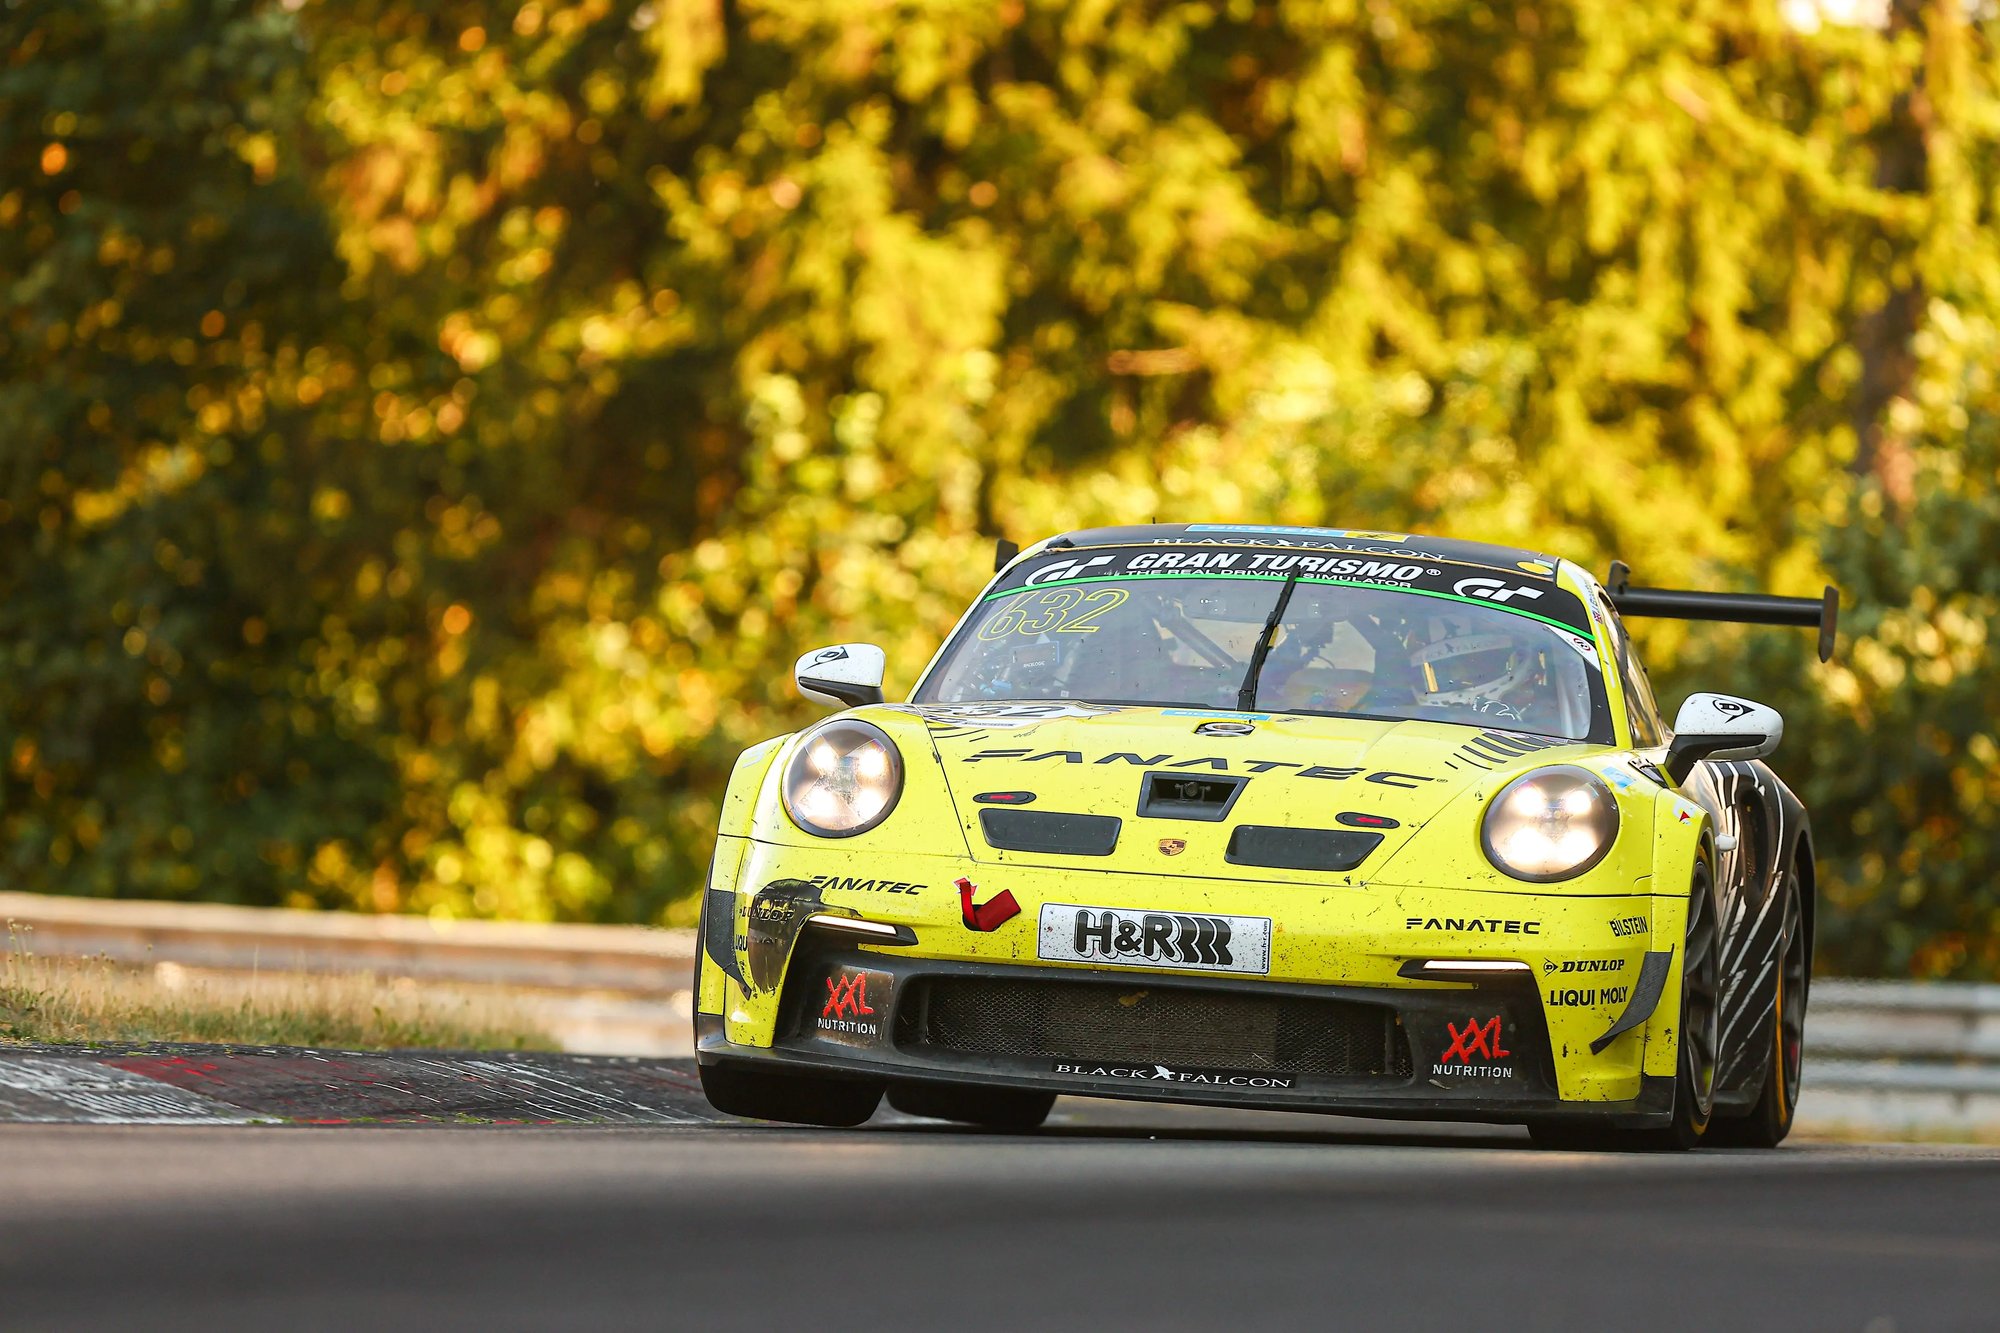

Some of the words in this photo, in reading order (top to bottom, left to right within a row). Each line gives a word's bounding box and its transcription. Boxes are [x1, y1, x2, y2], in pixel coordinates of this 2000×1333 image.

[1152, 537, 1270, 546] BLACK
[1300, 541, 1446, 561] FALCON
[1126, 552, 1243, 569] GRAN
[1302, 572, 1412, 588] SIMULATOR
[978, 587, 1131, 641] 632
[808, 875, 929, 896] FANATEC
[1406, 917, 1541, 935] FANATEC
[1609, 915, 1649, 938] BILSTEIN
[1559, 958, 1625, 973] DUNLOP
[823, 970, 875, 1019] XXL
[1549, 989, 1596, 1007] LIQUI
[1600, 986, 1628, 1005] MOLY
[817, 1017, 877, 1035] NUTRITION
[1442, 1014, 1511, 1065] XXL
[1055, 1063, 1148, 1080] BLACK
[1177, 1072, 1292, 1089] FALCON
[1432, 1063, 1513, 1079] NUTRITION
